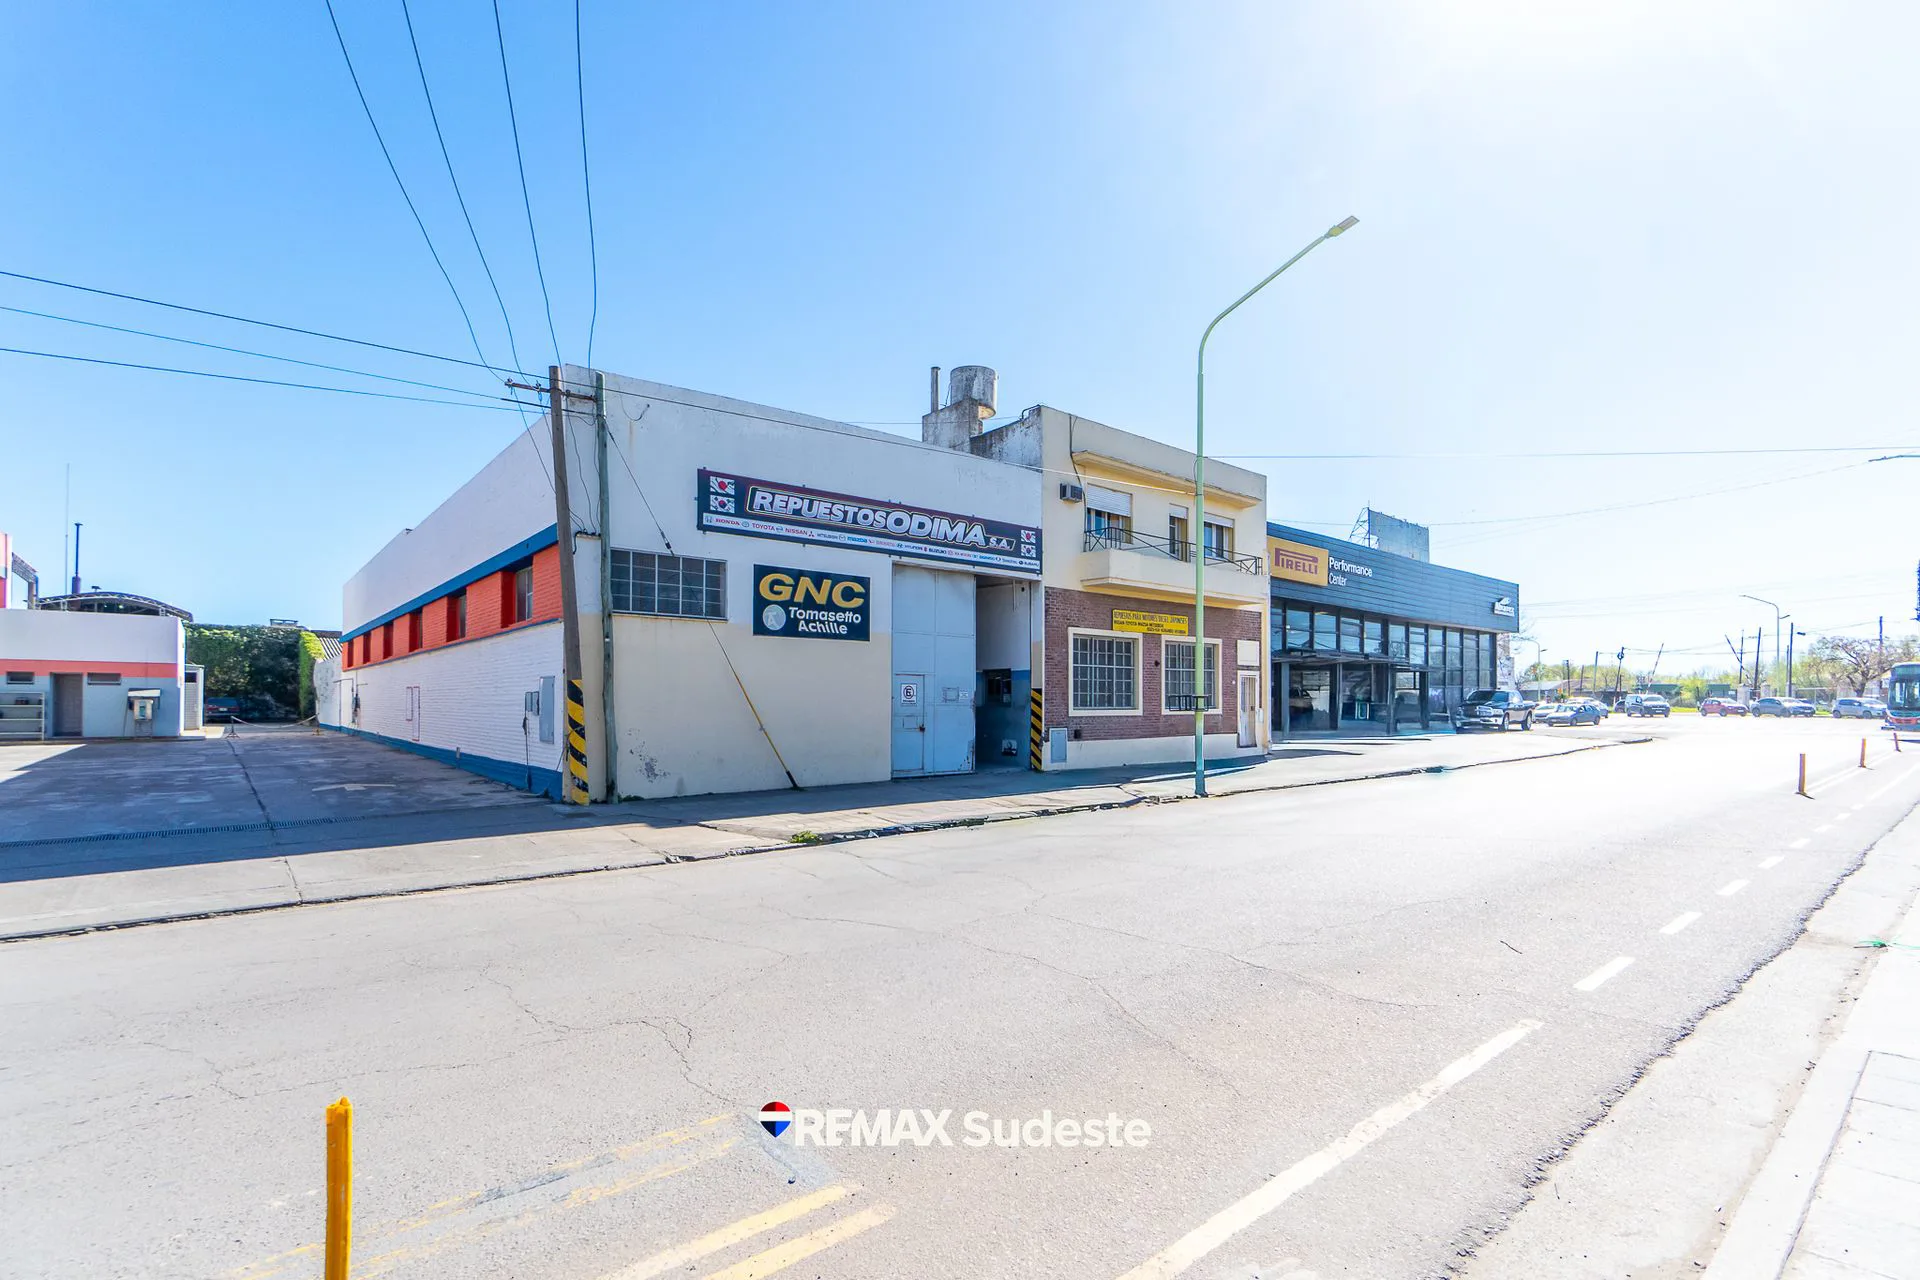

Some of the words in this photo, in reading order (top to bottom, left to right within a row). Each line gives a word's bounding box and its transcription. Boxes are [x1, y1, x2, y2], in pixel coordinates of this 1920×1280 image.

[715, 518, 740, 526] HONDA
[752, 522, 775, 531] TOYOTA
[784, 527, 808, 536] NISSAN
[753, 489, 888, 527] REPUESTOS
[886, 511, 987, 546] ODIMA
[1274, 547, 1319, 575] PIRELLI
[1329, 557, 1373, 577] Performance
[1328, 572, 1347, 586] Center
[759, 573, 865, 608] GNC
[788, 606, 861, 623] Tomasetto
[798, 620, 848, 634] Achille
